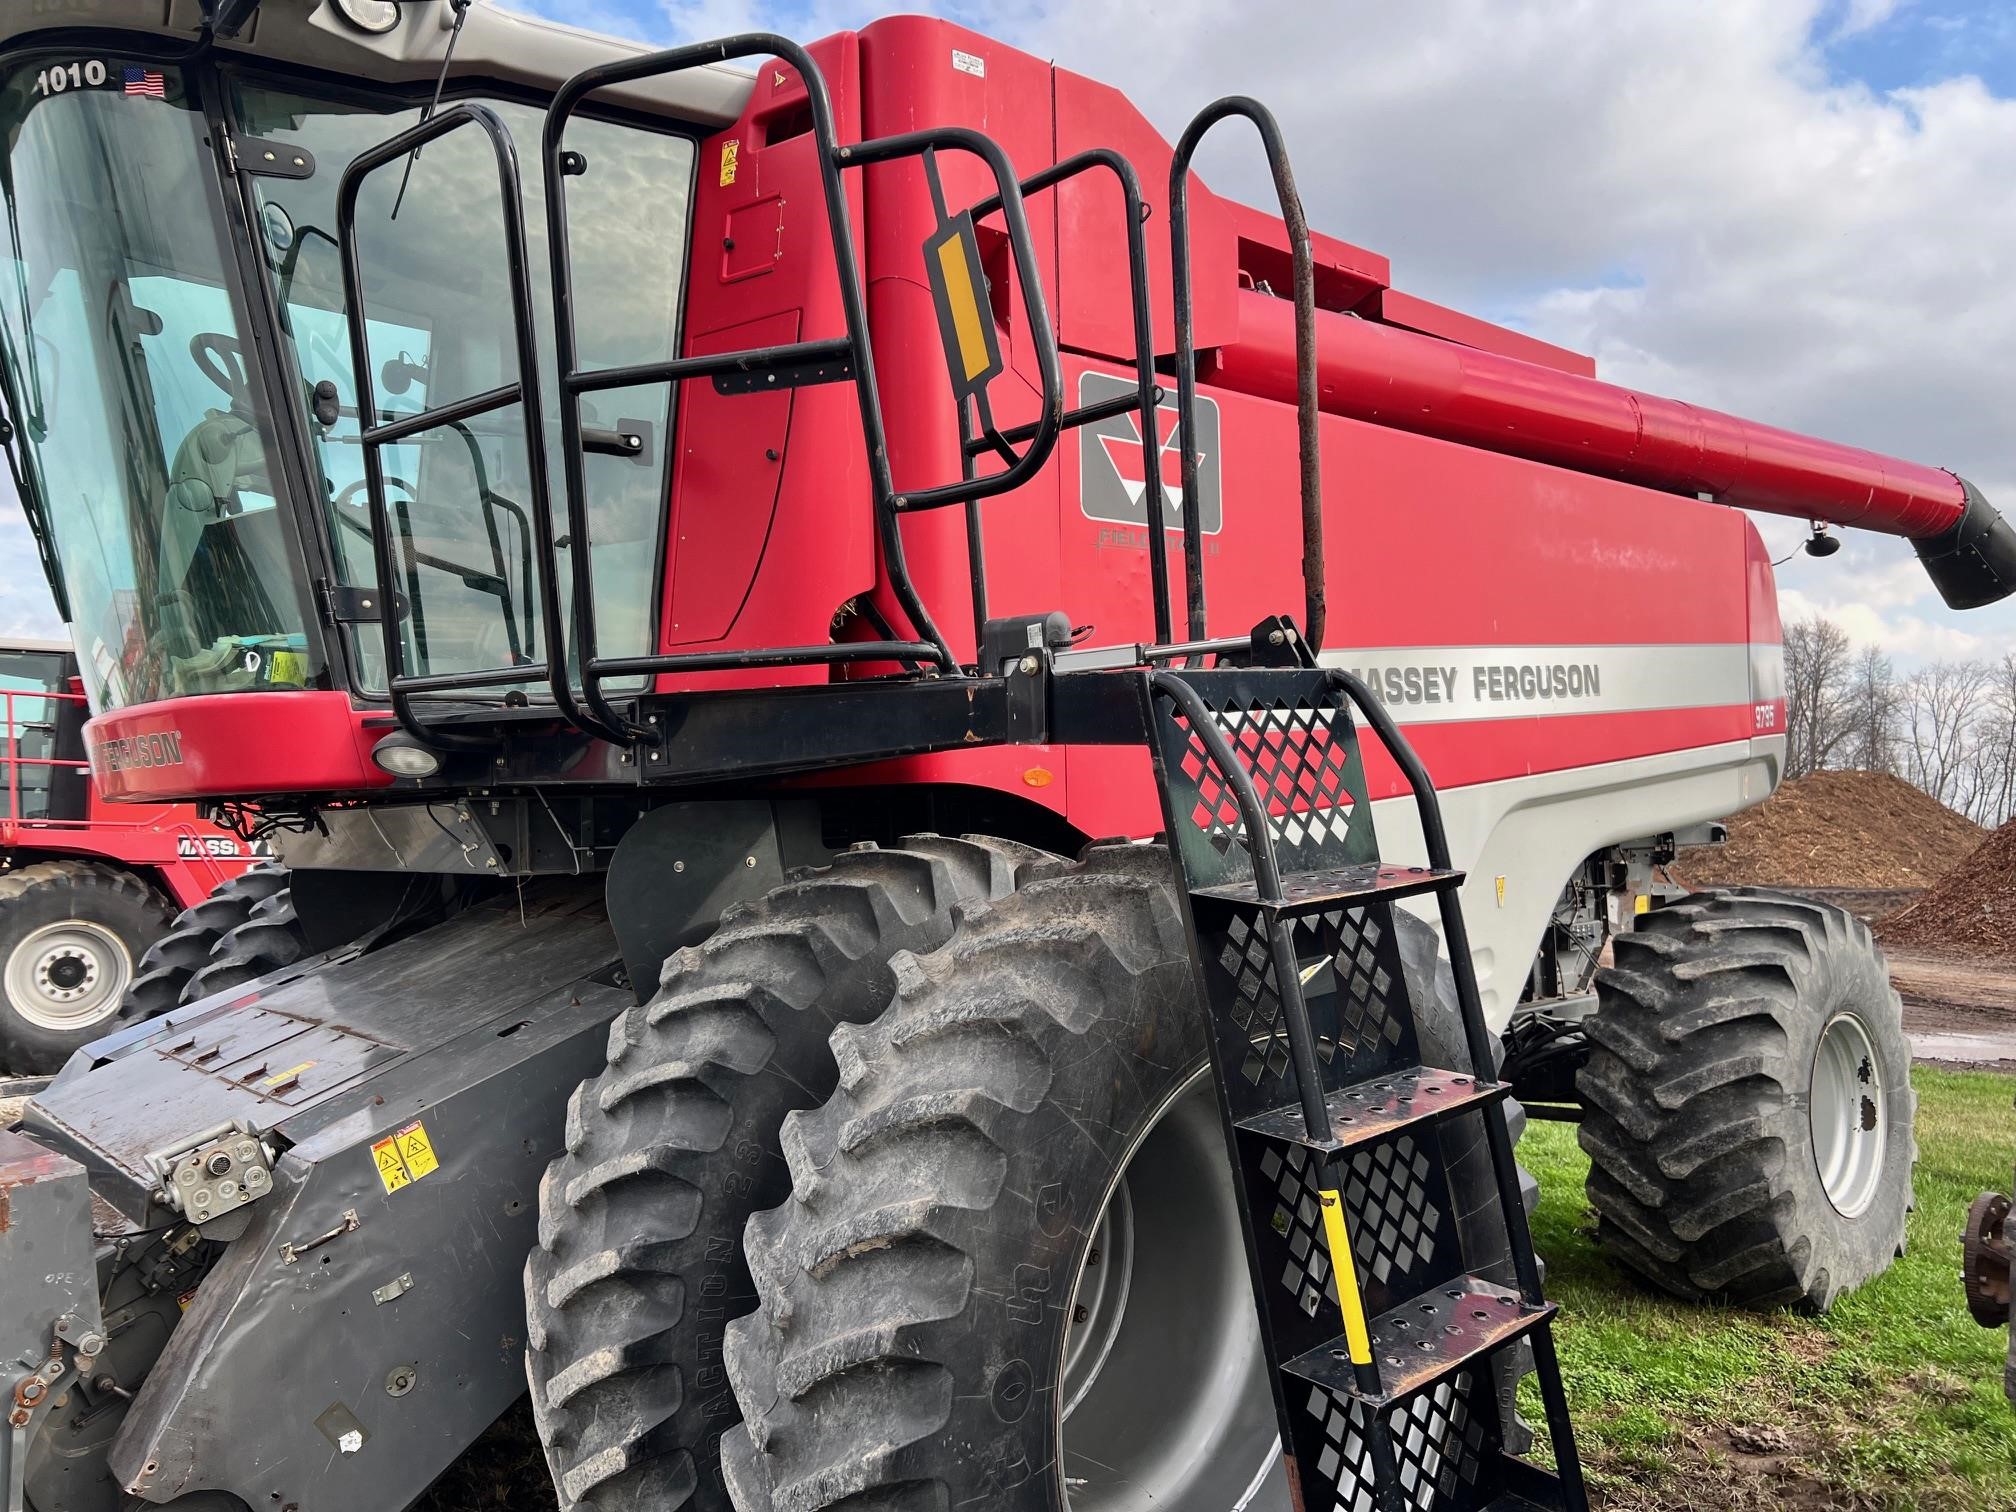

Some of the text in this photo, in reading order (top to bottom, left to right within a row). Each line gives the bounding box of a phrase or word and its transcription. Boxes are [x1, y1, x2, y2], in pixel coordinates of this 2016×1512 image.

[33, 59, 106, 96] 1010
[1353, 664, 1600, 705] ASSEY FERGUSON
[177, 839, 260, 856] MASSY
